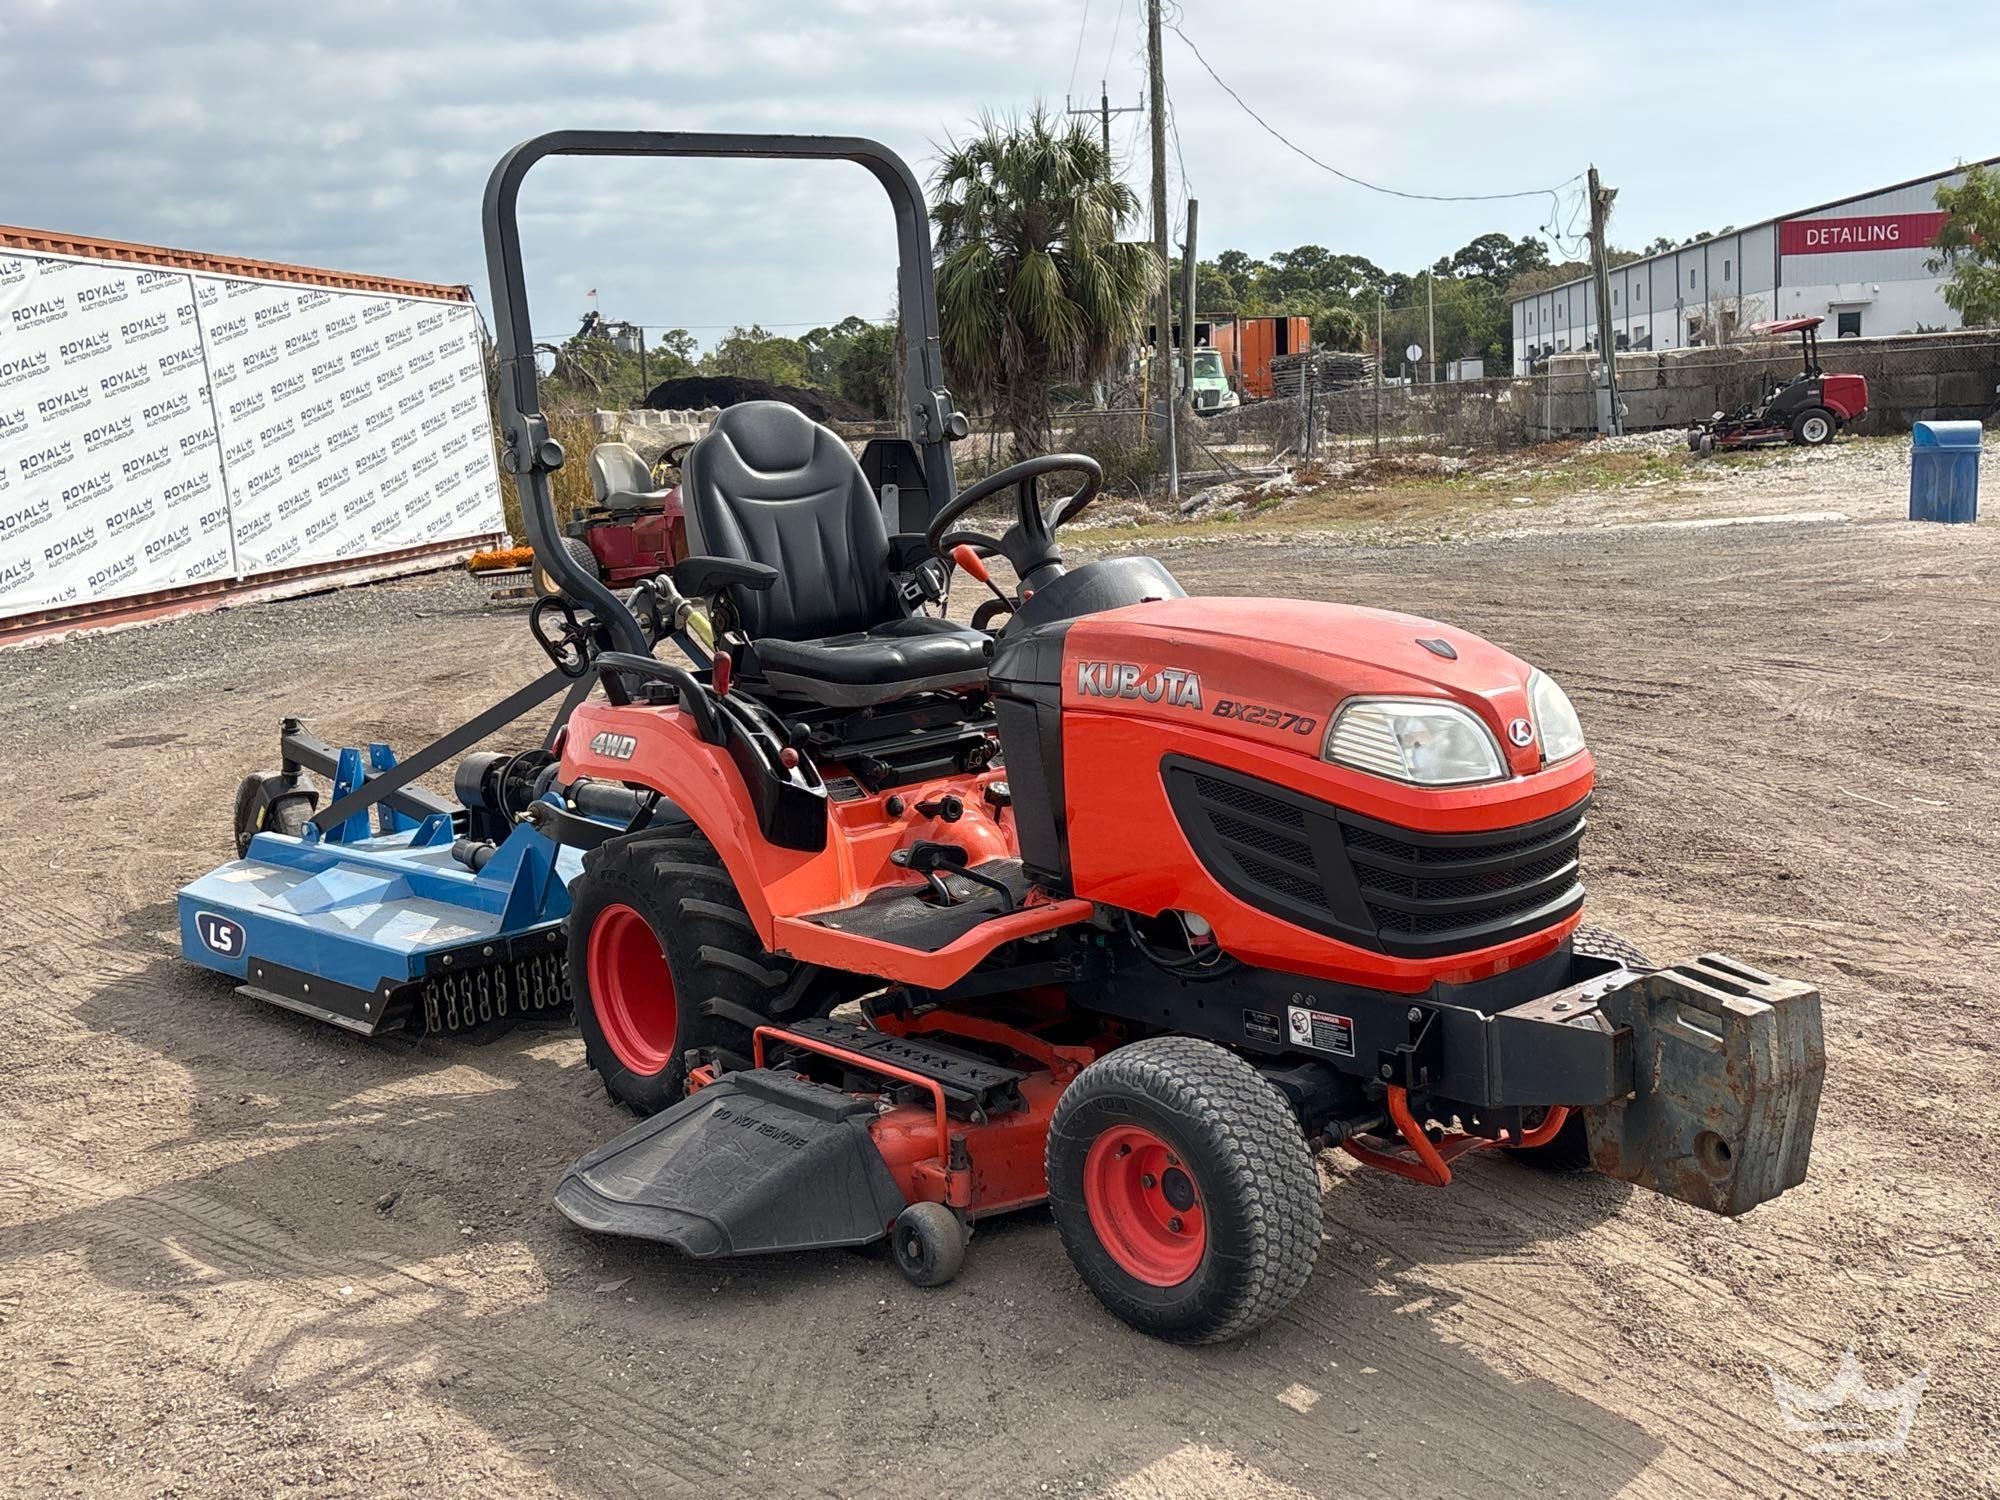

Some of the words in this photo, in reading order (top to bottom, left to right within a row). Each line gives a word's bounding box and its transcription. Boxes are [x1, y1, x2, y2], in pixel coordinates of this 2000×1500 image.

[1806, 224, 1899, 246] DETAILING
[40, 262, 68, 275] AUCTION
[78, 284, 116, 303] ROYAL
[140, 284, 164, 294] AUCTION
[12, 301, 55, 322] ROYAL
[82, 299, 108, 312] AUCTION
[108, 294, 128, 304] GROUP
[255, 304, 282, 321] ROYAL
[362, 304, 385, 318] ROYAL
[16, 318, 45, 331] AUCTION
[46, 311, 68, 322] GROUP
[121, 317, 158, 336] ROYAL
[210, 321, 239, 338] ROYAL
[326, 315, 351, 333] ROYAL
[125, 332, 149, 344] AUCTION
[150, 326, 169, 336] GROUP
[285, 332, 311, 349] ROYAL
[60, 336, 100, 357] ROYAL
[64, 352, 90, 366] AUCTION
[91, 345, 111, 356] GROUP
[351, 342, 374, 360] ROYAL
[159, 348, 194, 368] ROYAL
[243, 348, 270, 367] ROYAL
[408, 355, 429, 368] ROYAL
[28, 366, 50, 378] GROUP
[163, 364, 186, 376] AUCTION
[312, 359, 337, 377] ROYAL
[377, 368, 398, 384] ROYAL
[100, 368, 139, 390] ROYAL
[105, 384, 130, 399] AUCTION
[131, 377, 151, 389] GROUP
[271, 377, 298, 395] ROYAL
[429, 377, 449, 392] ROYAL
[340, 382, 365, 401] ROYAL
[399, 393, 419, 409] ROYAL
[38, 391, 79, 413] ROYAL
[42, 407, 69, 422] AUCTION
[70, 399, 91, 411] GROUP
[143, 399, 180, 420] ROYAL
[230, 396, 257, 415] ROYAL
[451, 399, 471, 414] ROYAL
[147, 415, 171, 428] AUCTION
[172, 406, 191, 417] GROUP
[301, 404, 326, 421] ROYAL
[366, 408, 388, 426] ROYAL
[6, 423, 28, 437] GROUP
[260, 422, 287, 441] ROYAL
[421, 415, 440, 430] ROYAL
[84, 421, 122, 444] ROYAL
[88, 438, 114, 453] AUCTION
[115, 429, 134, 442] GROUP
[180, 427, 215, 449] ROYAL
[327, 428, 352, 446] ROYAL
[391, 432, 411, 449] ROYAL
[184, 442, 207, 457] AUCTION
[442, 436, 461, 452] ROYAL
[20, 446, 62, 471] ROYAL
[24, 464, 52, 480] AUCTION
[53, 454, 74, 468] GROUP
[122, 451, 160, 475] ROYAL
[288, 448, 314, 467] ROYAL
[356, 451, 380, 469] ROYAL
[412, 456, 431, 471] ROYAL
[465, 458, 484, 473] ROYAL
[127, 467, 151, 483] AUCTION
[152, 458, 171, 471] GROUP
[248, 470, 274, 490] ROYAL
[62, 478, 101, 502] ROYAL
[164, 478, 200, 500] ROYAL
[318, 471, 342, 490] ROYAL
[381, 474, 402, 492] ROYAL
[435, 476, 454, 491] ROYAL
[67, 494, 93, 510] AUCTION
[94, 485, 113, 498] GROUP
[168, 493, 192, 508] AUCTION
[193, 484, 211, 496] GROUP
[278, 493, 304, 513] ROYAL
[344, 495, 368, 514] ROYAL
[405, 494, 425, 512] ROYAL
[106, 504, 144, 529] ROYAL
[110, 520, 136, 537] AUCTION
[137, 511, 156, 524] GROUP
[371, 516, 394, 534] ROYAL
[1, 524, 30, 541] AUCTION
[30, 513, 52, 527] GROUP
[237, 517, 264, 539] ROYAL
[306, 517, 331, 537] ROYAL
[44, 534, 85, 560] ROYAL
[145, 532, 180, 556] ROYAL
[150, 546, 172, 564] AUCTION
[174, 537, 191, 550] GROUP
[49, 550, 76, 568] AUCTION
[77, 540, 97, 554] GROUP
[88, 561, 126, 587] ROYAL
[186, 555, 218, 579] ROYAL
[11, 572, 35, 588] GROUP
[93, 577, 118, 596] AUCTION
[119, 566, 138, 580] GROUP
[1077, 661, 1202, 710] KUBOTA
[1211, 700, 1317, 736] BX2370
[590, 731, 637, 760] 4WD
[210, 922, 232, 952] LS
[1316, 1014, 1340, 1024] DANGER
[712, 1108, 732, 1120] DO
[732, 1114, 760, 1130] NOT
[755, 1123, 808, 1150] REMOVE
